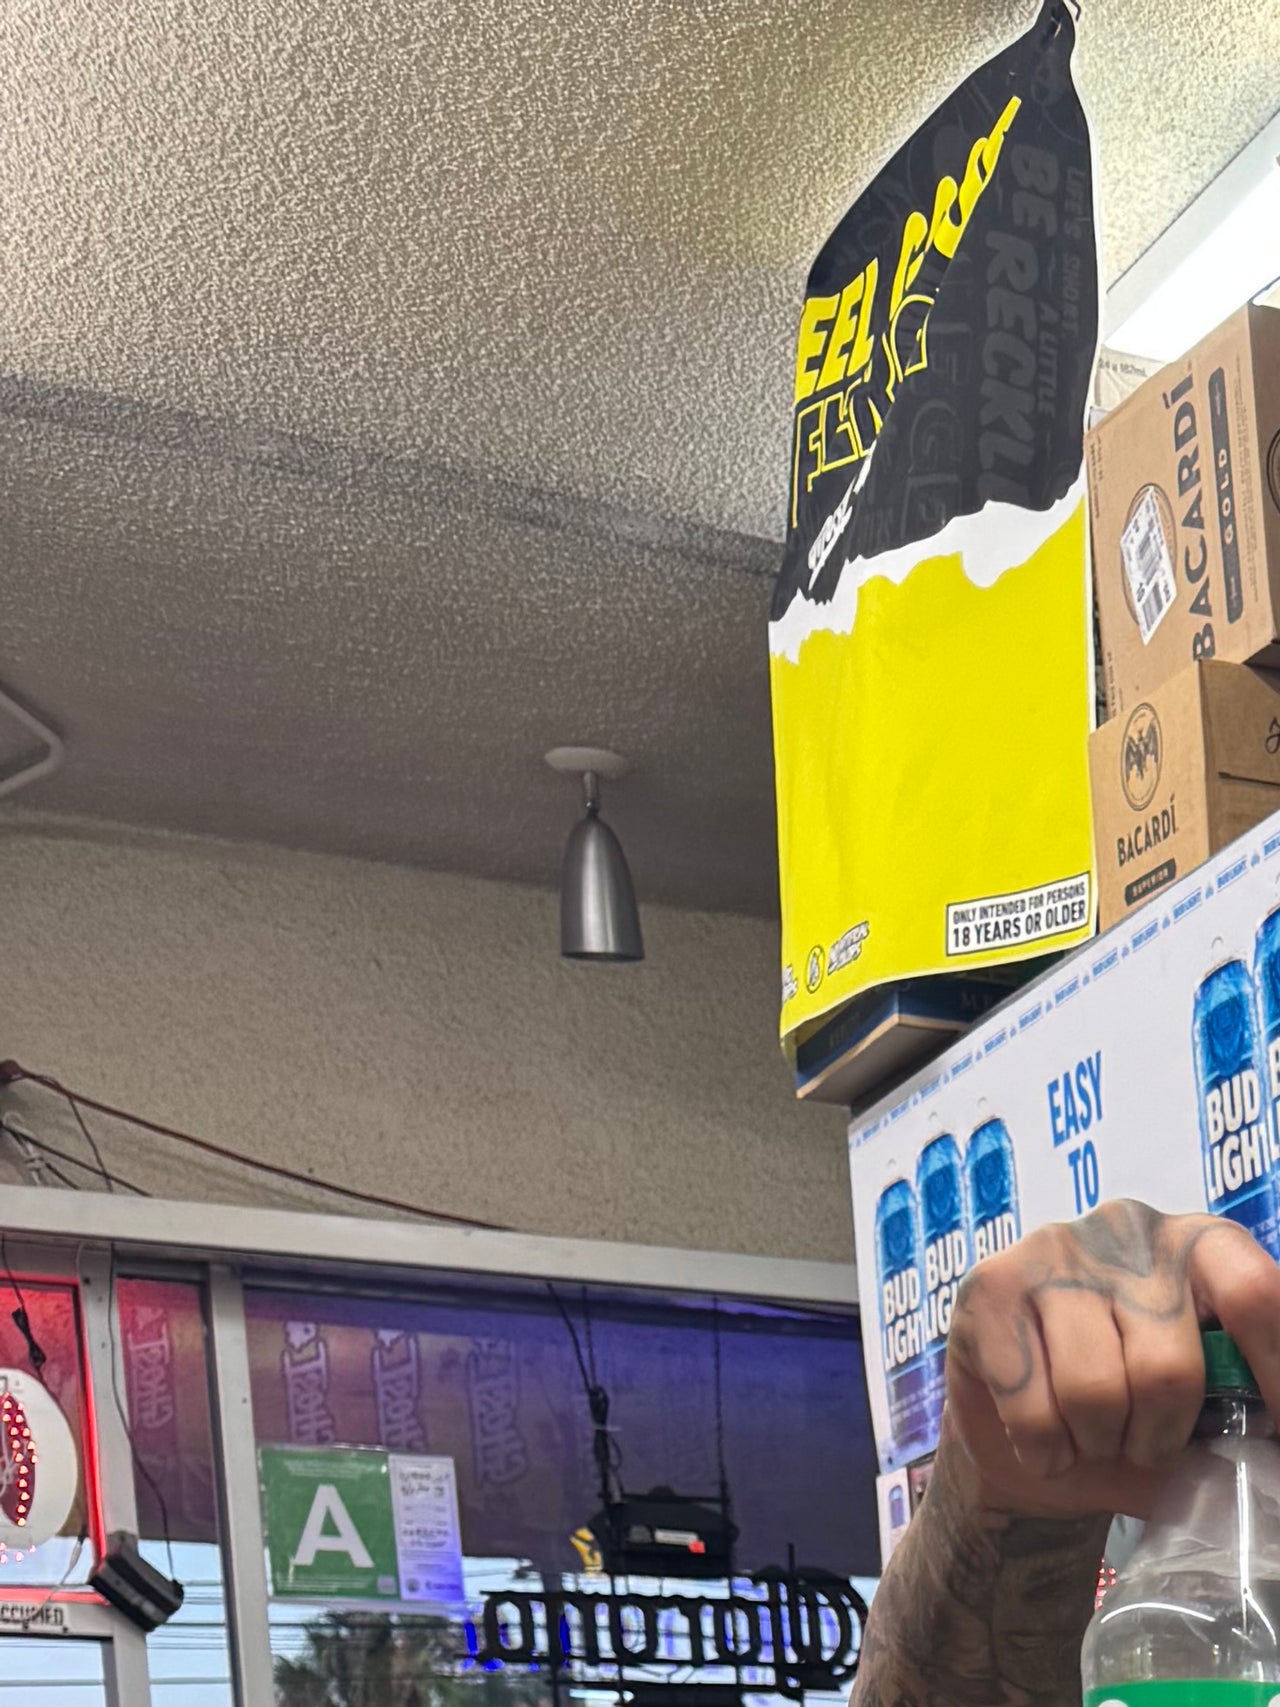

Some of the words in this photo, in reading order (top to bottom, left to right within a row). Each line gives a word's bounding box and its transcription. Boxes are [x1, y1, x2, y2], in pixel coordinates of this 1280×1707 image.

[1219, 449, 1233, 544] GOLD
[953, 908, 976, 924] ONLY
[979, 899, 1027, 918] INTENDED
[1029, 894, 1045, 911] FOR
[1046, 882, 1085, 906] PERSONS
[953, 927, 970, 947] 18
[974, 918, 1021, 944] YEARS
[1025, 914, 1042, 934] OR
[1045, 901, 1086, 929] OLDER
[1048, 1051, 1103, 1148] EASY
[1068, 1140, 1098, 1215] TO
[884, 1268, 918, 1326] BUD
[885, 1316, 924, 1369] LIGHT
[292, 1484, 374, 1569] A
